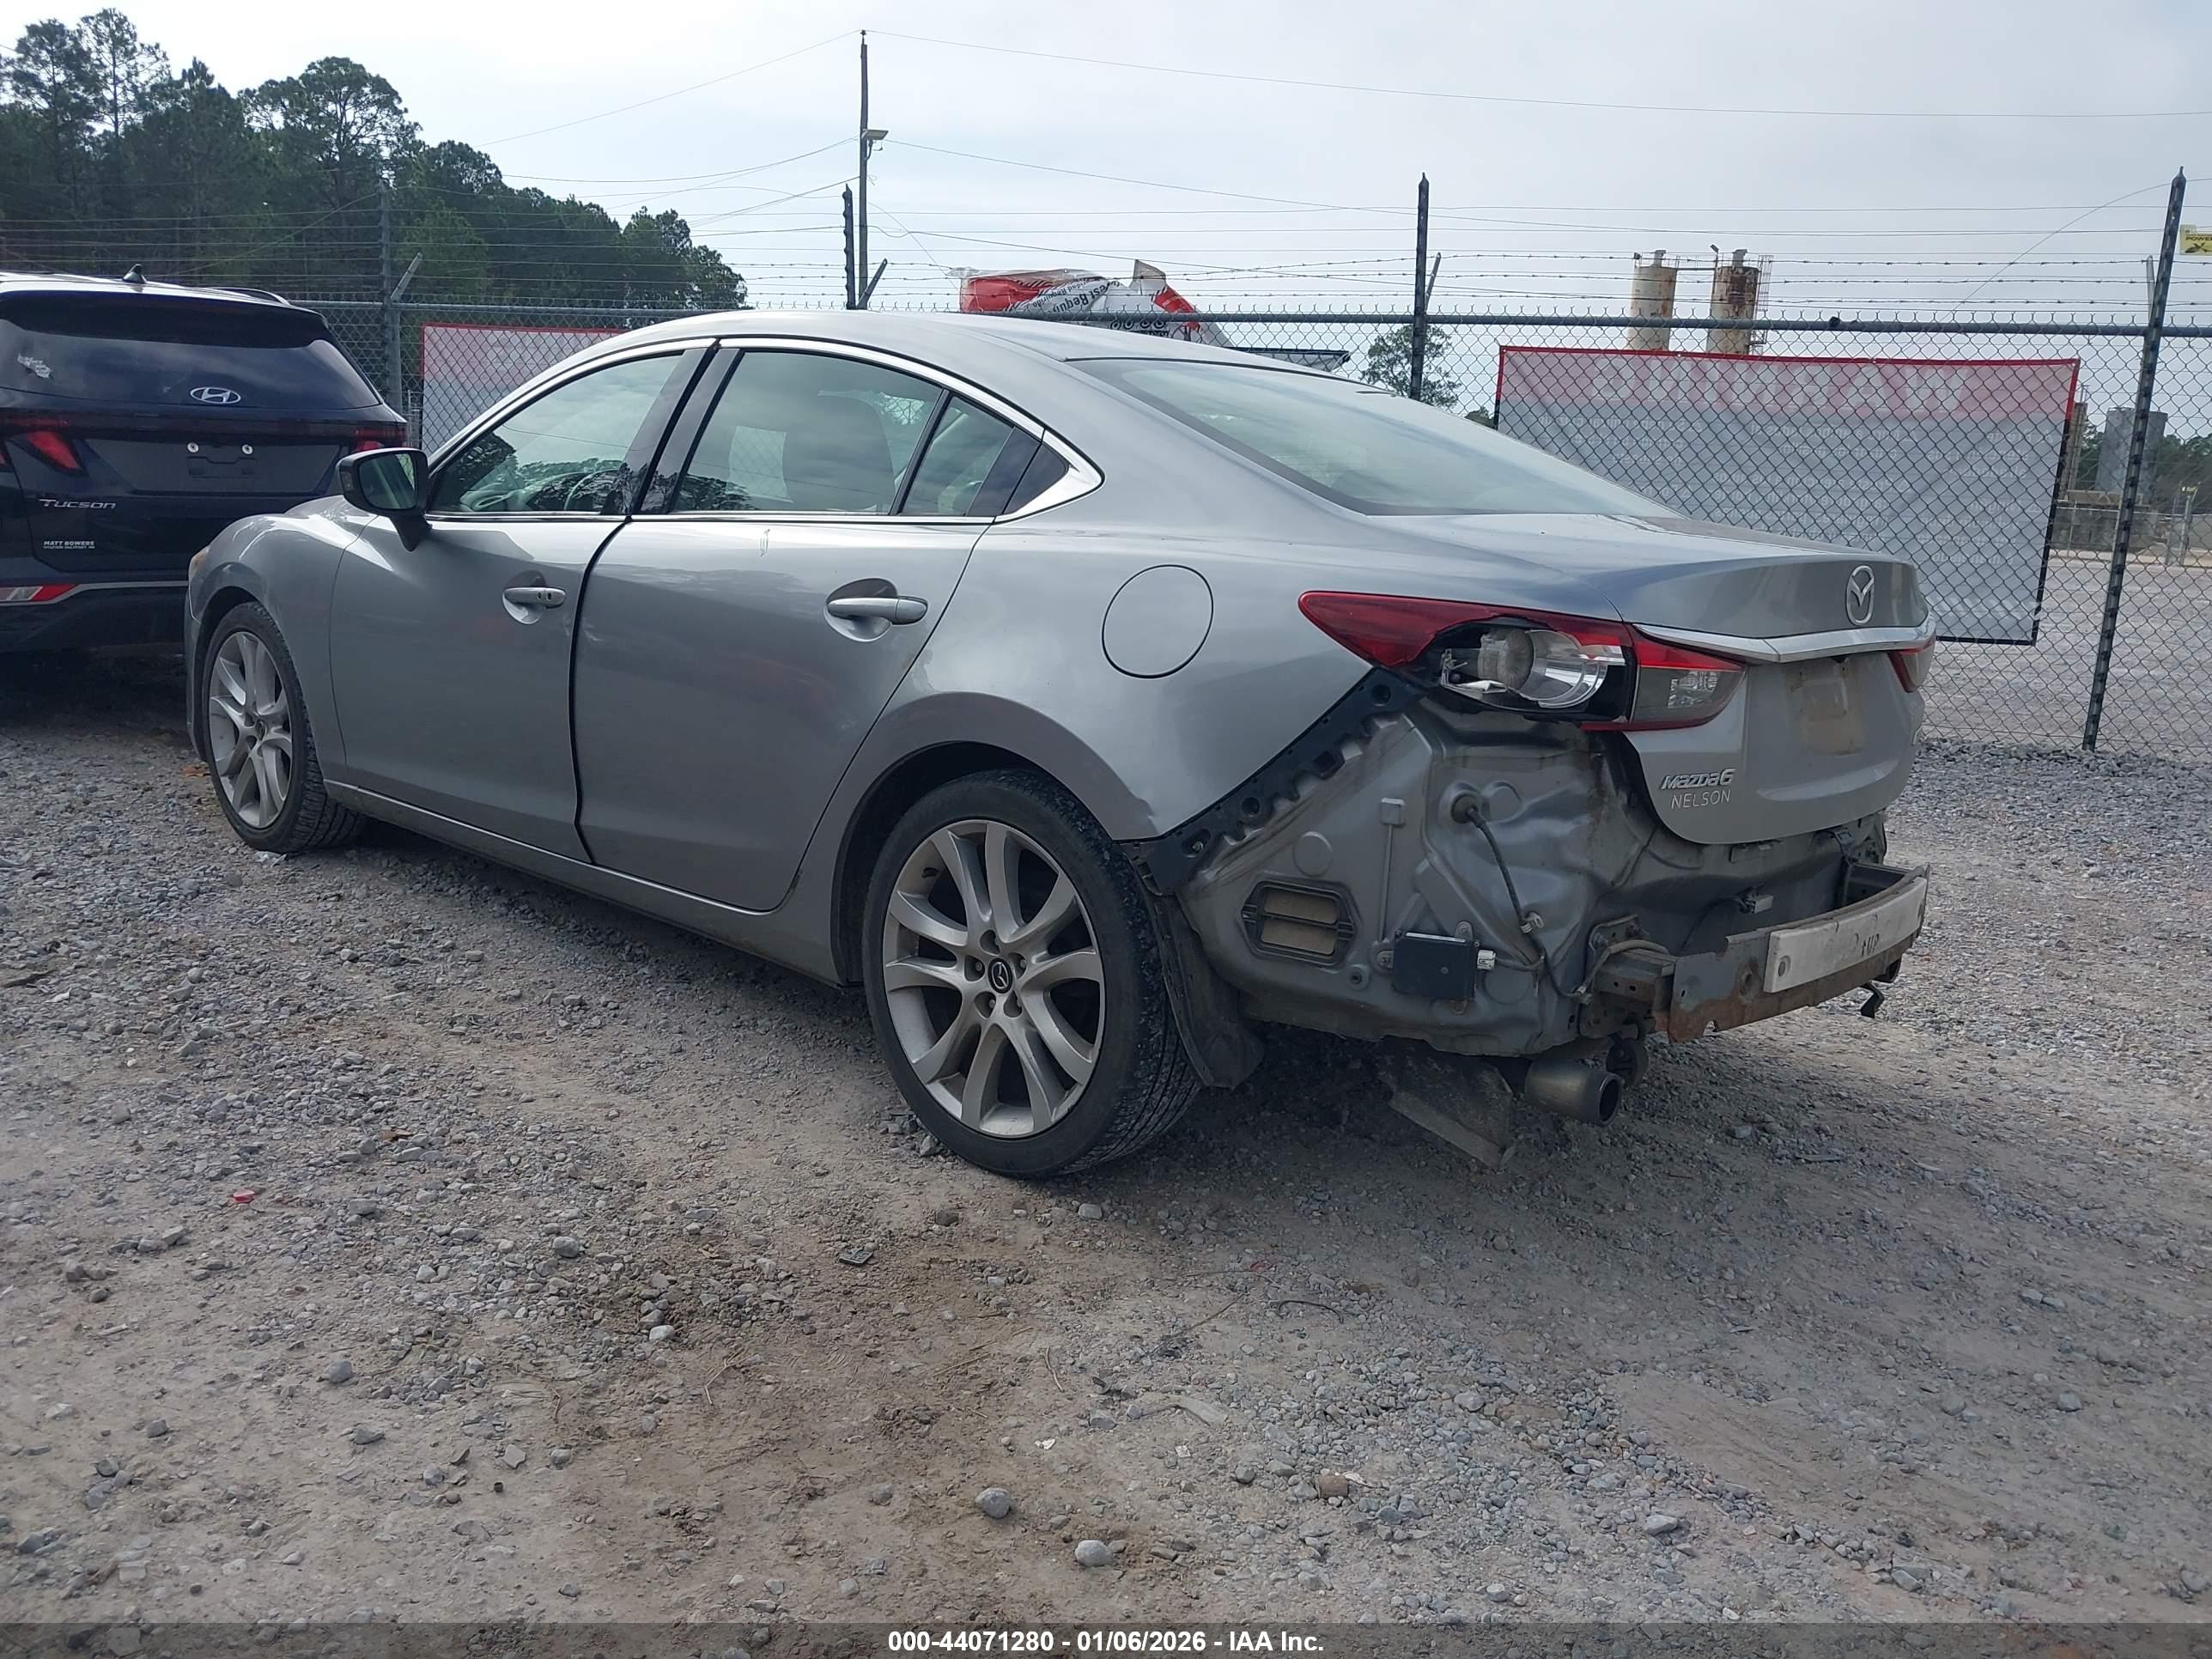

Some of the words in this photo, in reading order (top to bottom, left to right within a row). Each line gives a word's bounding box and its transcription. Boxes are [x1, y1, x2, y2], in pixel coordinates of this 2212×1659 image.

[1053, 293, 1089, 313] Requi
[39, 498, 117, 509] Tucson
[1671, 789, 1731, 810] NELSON
